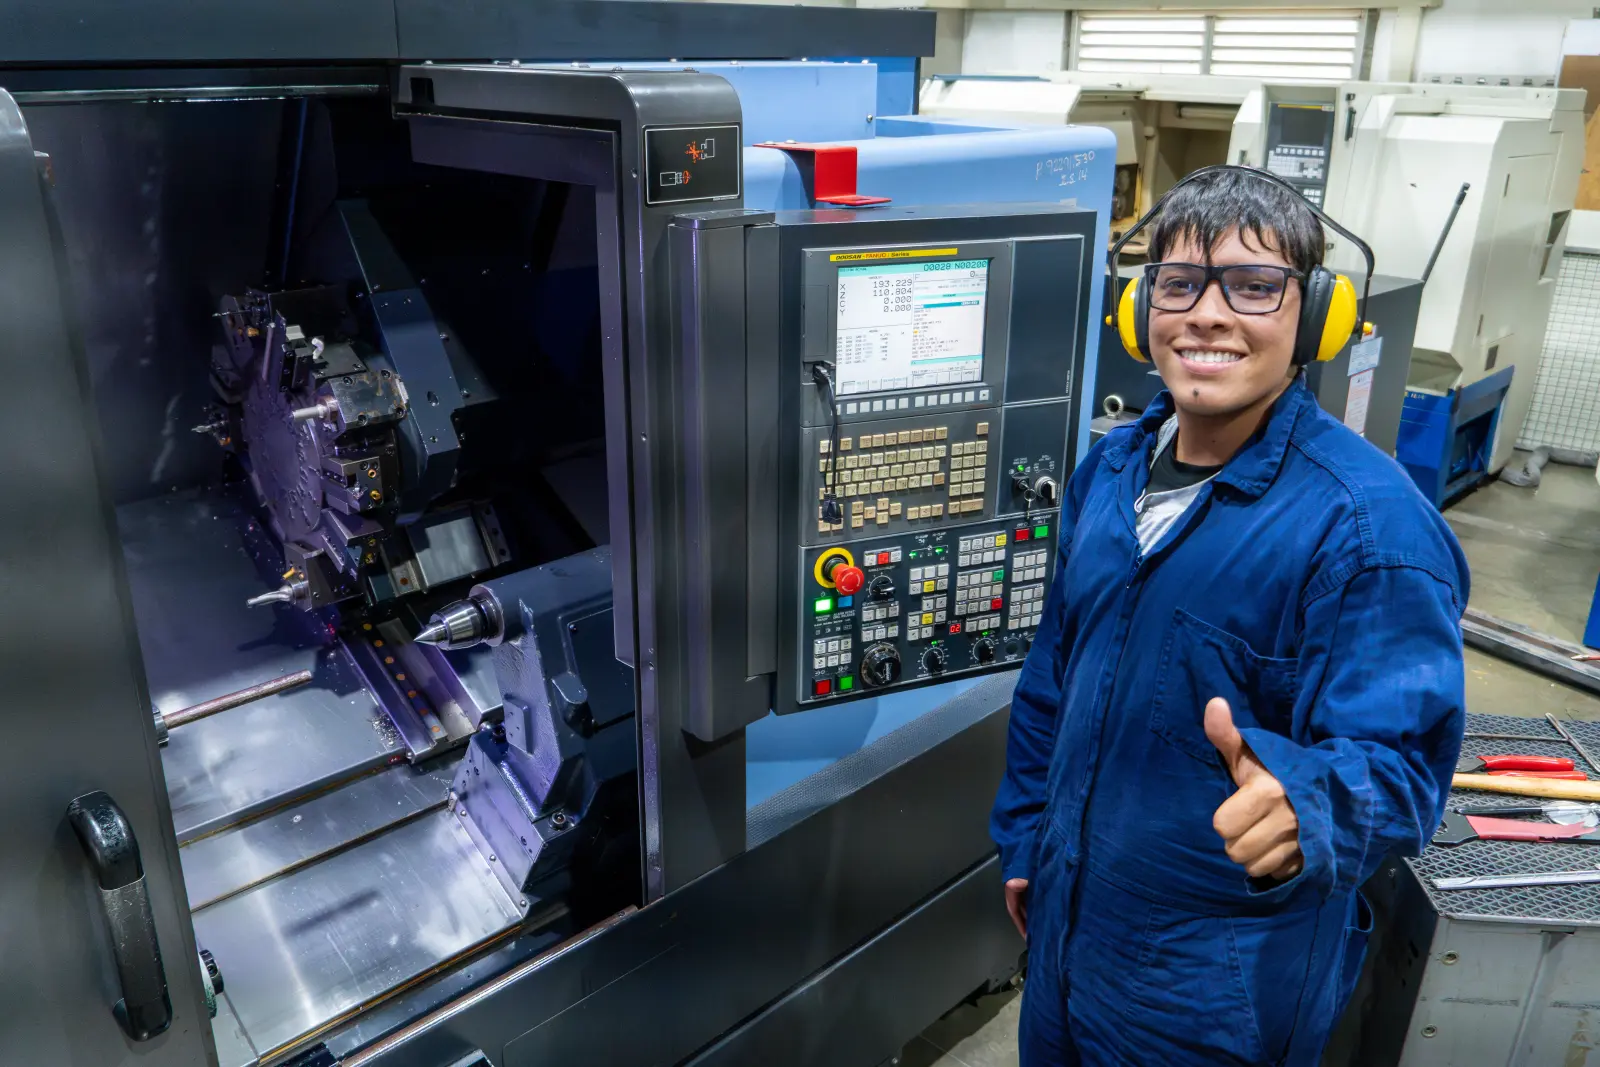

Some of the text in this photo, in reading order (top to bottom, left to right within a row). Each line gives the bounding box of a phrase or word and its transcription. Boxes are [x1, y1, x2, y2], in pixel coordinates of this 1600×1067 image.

[954, 260, 987, 270] N00200
[873, 279, 913, 289] 193.229
[873, 288, 912, 297] 110.804
[883, 296, 912, 305] 0.000
[883, 305, 911, 313] 0.000
[950, 624, 961, 633] 02
